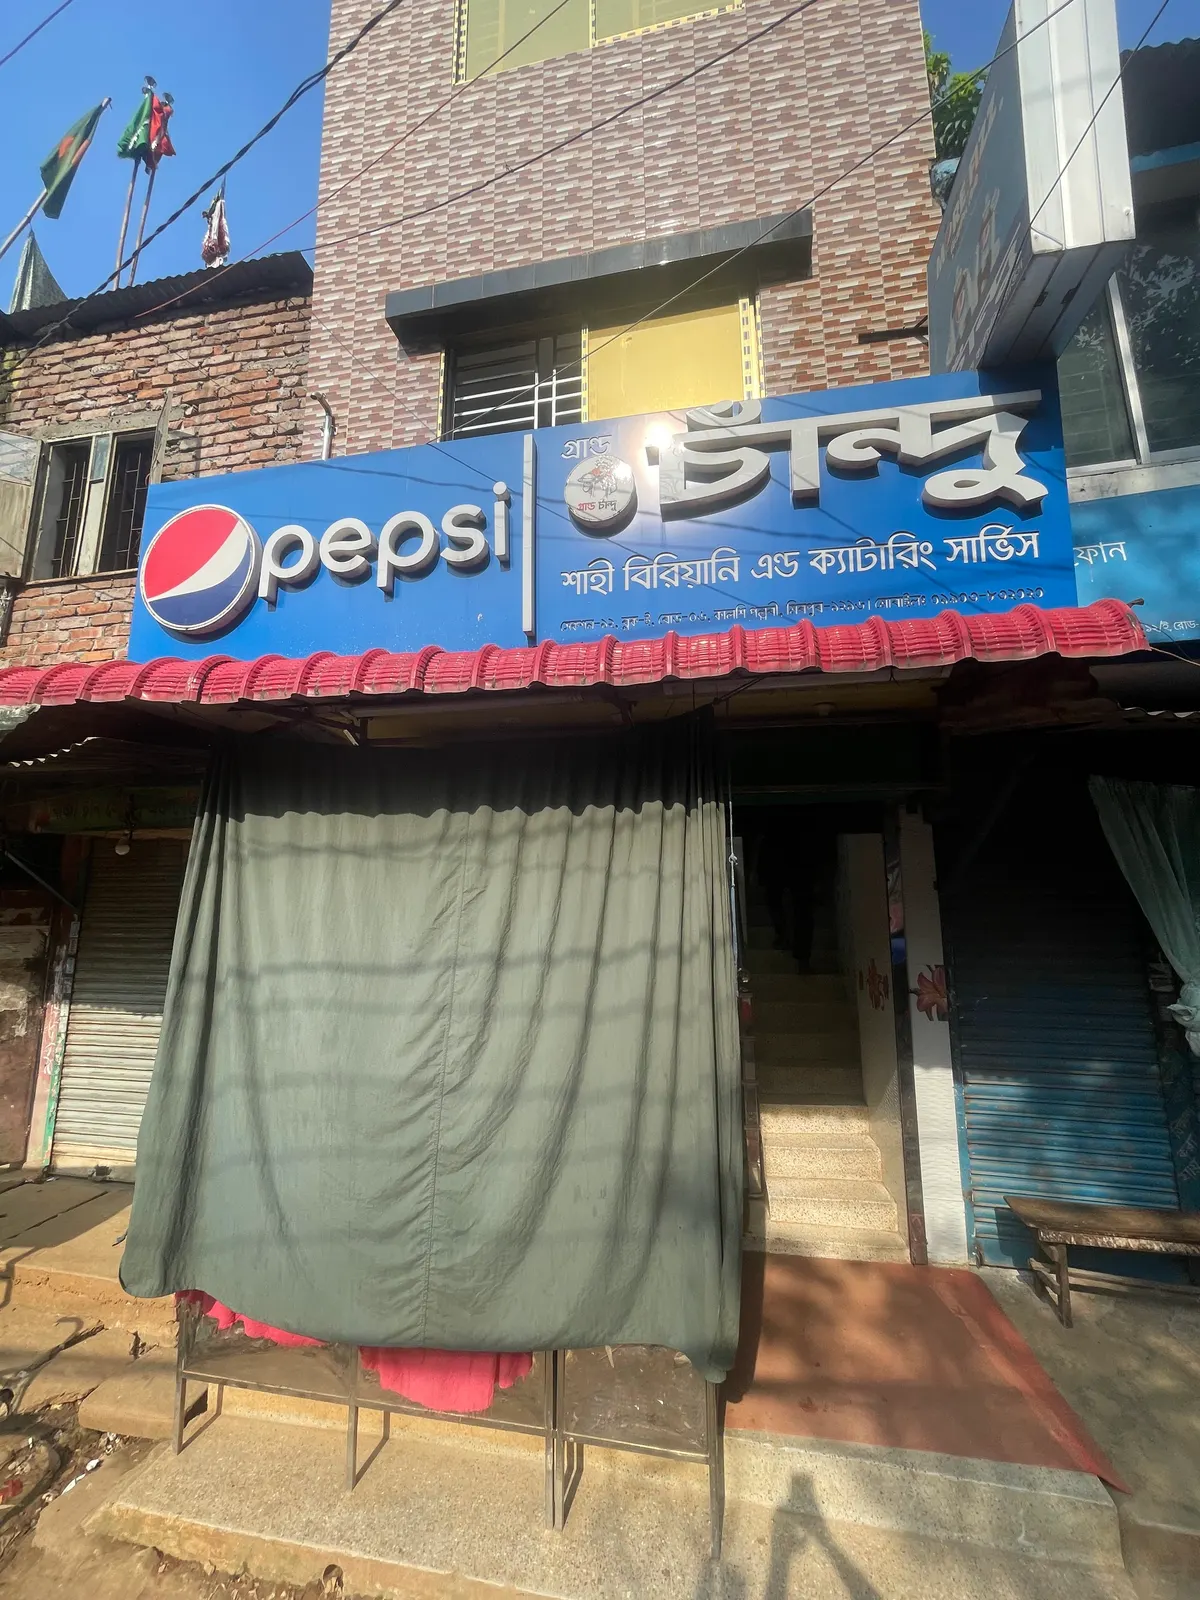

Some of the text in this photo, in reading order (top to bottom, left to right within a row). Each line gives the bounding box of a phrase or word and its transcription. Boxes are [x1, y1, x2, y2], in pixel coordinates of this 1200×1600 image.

[258, 481, 510, 603] pepsi
[560, 557, 615, 595] শাহী
[622, 546, 741, 591] বিরিয়ানি
[808, 531, 937, 575] ক্যাটারিং
[943, 522, 1039, 564] সার্ভিস
